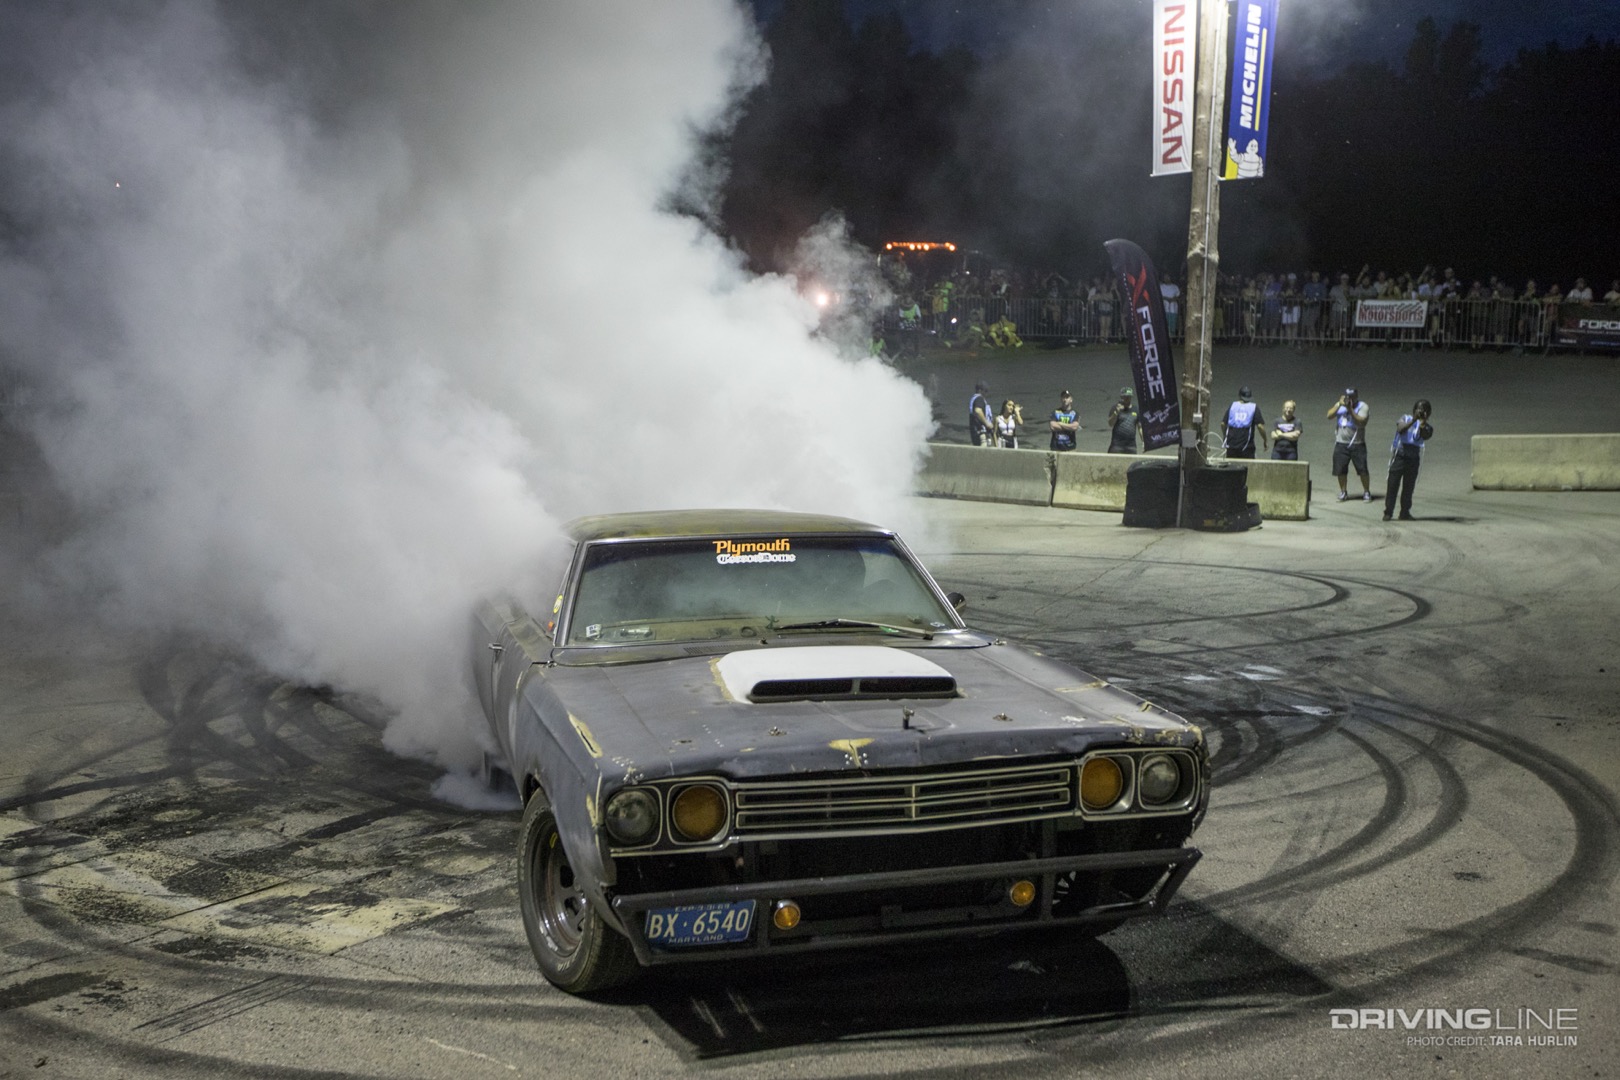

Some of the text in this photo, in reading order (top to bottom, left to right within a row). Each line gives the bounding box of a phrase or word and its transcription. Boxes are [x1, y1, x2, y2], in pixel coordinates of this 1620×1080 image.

[1239, 4, 1262, 129] MICHELIN
[1162, 4, 1186, 165] NISSAN
[1358, 308, 1424, 323] Motorsports
[1578, 318, 1620, 330] FORC
[712, 538, 791, 557] Plymouth
[668, 933, 724, 944] MARYLAND
